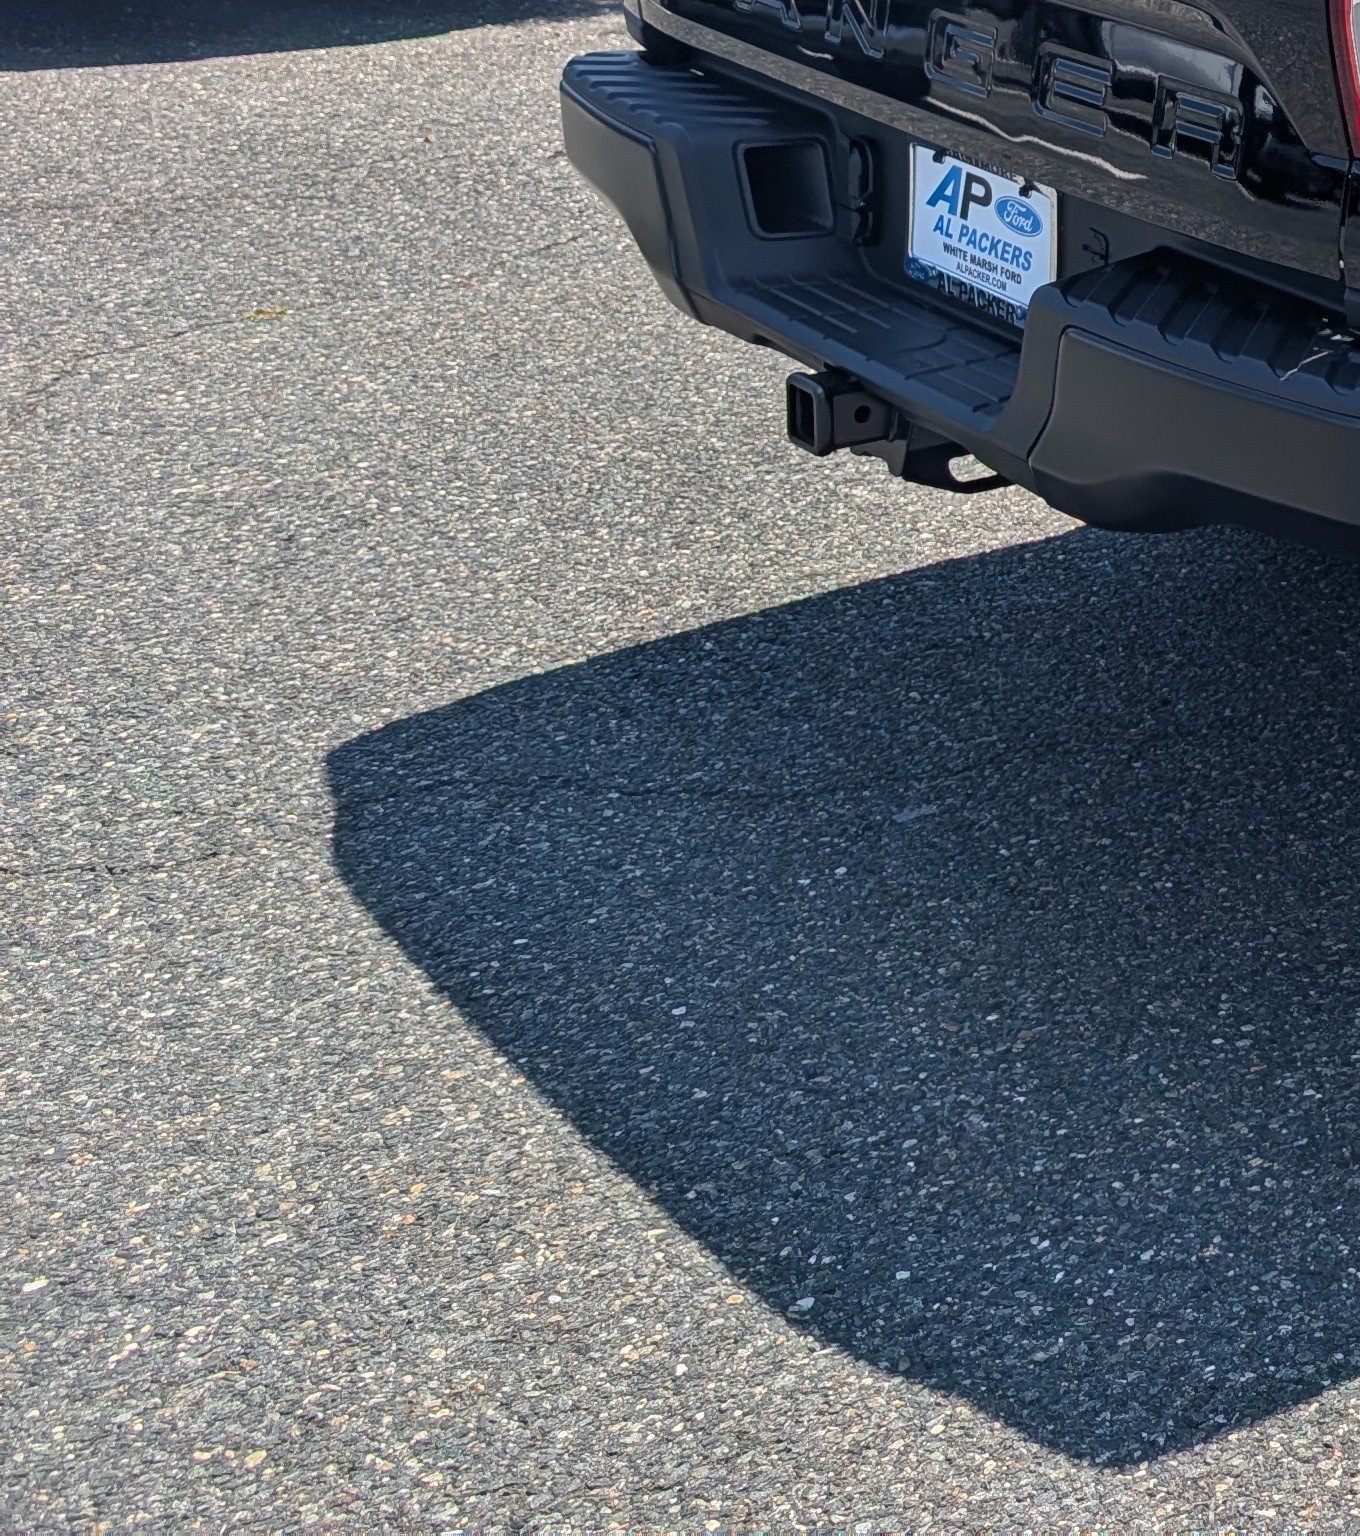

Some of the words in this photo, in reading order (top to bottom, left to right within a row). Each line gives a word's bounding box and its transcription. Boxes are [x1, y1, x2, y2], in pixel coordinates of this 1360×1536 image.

[926, 164, 993, 221] AP
[1002, 200, 1033, 232] Ford
[933, 214, 954, 240] AL
[957, 223, 1033, 272] PACKERS
[943, 241, 968, 263] WHITE
[969, 251, 998, 276] MARSH
[1000, 266, 1022, 285] FORD
[955, 261, 1008, 292] ALPACKER.COM
[938, 272, 956, 297] AL
